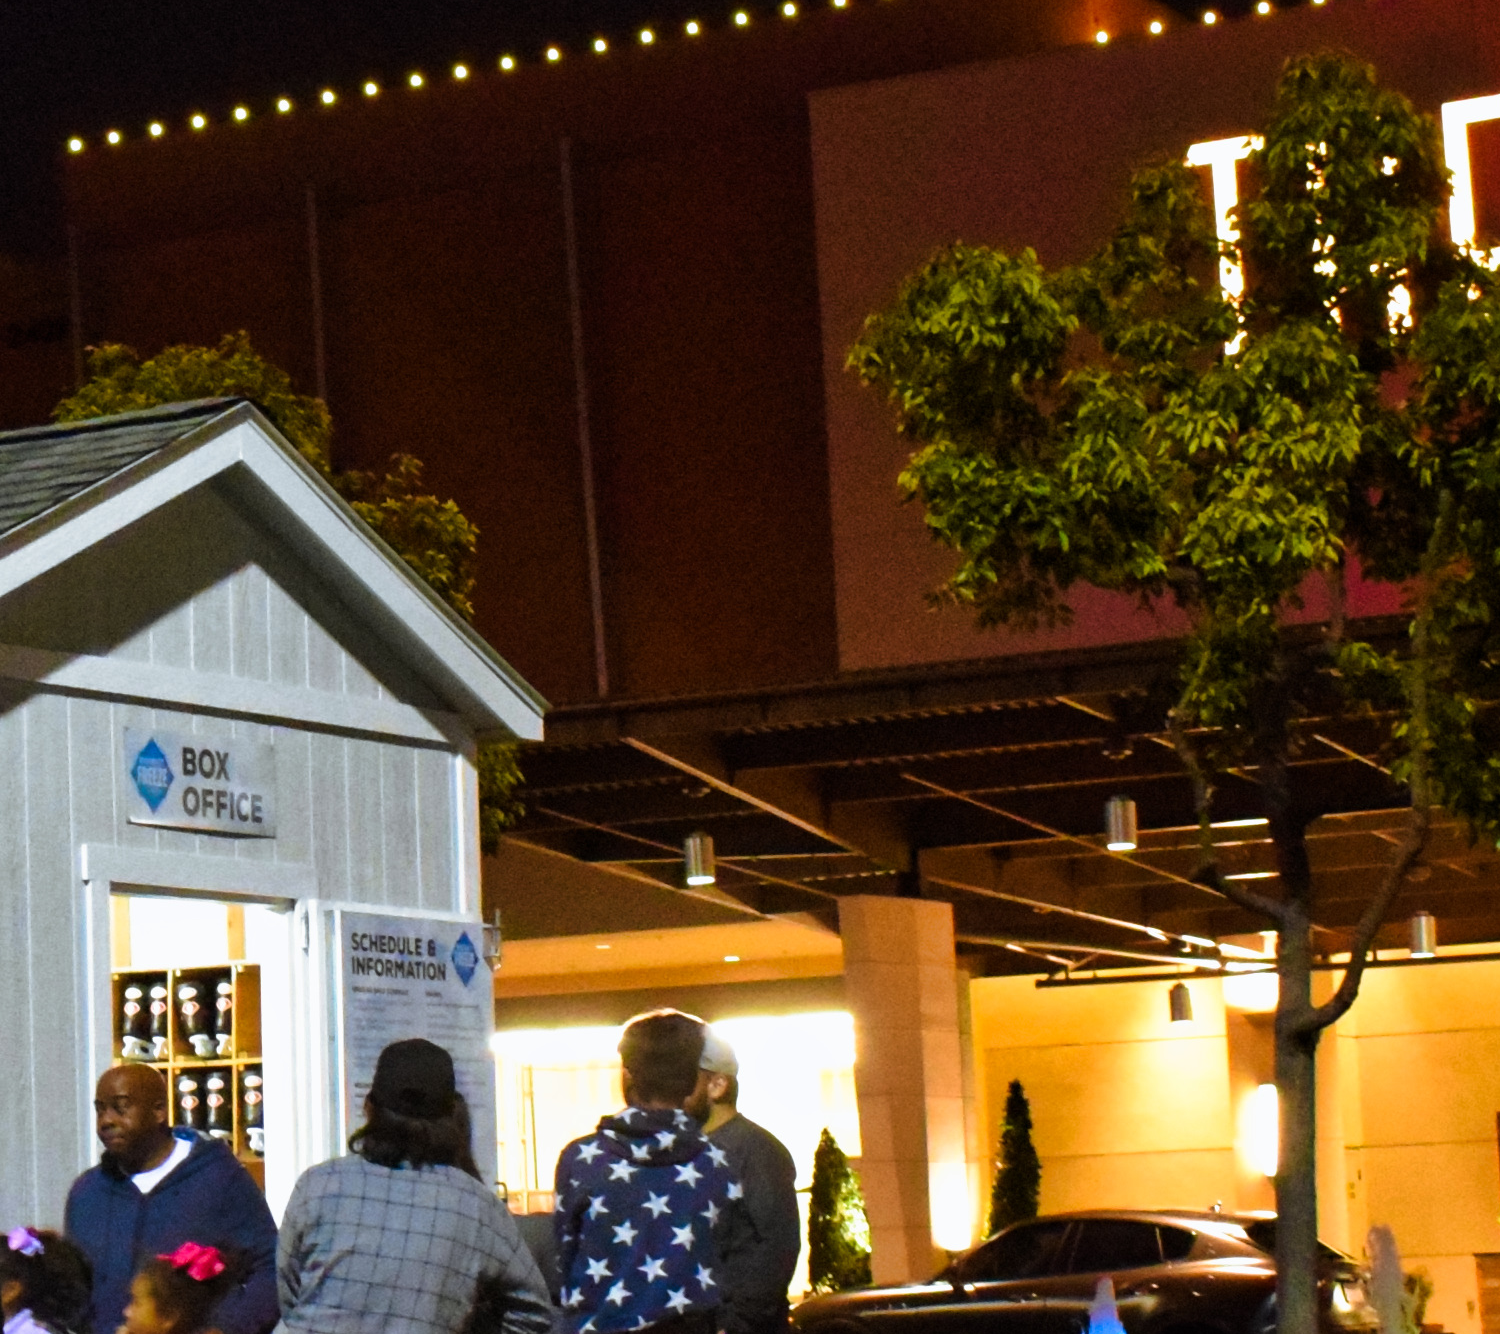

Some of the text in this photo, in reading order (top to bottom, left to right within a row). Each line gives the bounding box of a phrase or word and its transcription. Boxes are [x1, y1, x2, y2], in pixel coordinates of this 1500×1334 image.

[182, 747, 230, 782] BOX
[182, 786, 263, 824] OFFICE
[351, 932, 422, 957] SCHEDULE
[427, 938, 436, 957] &
[351, 956, 447, 981] INFORMATION
